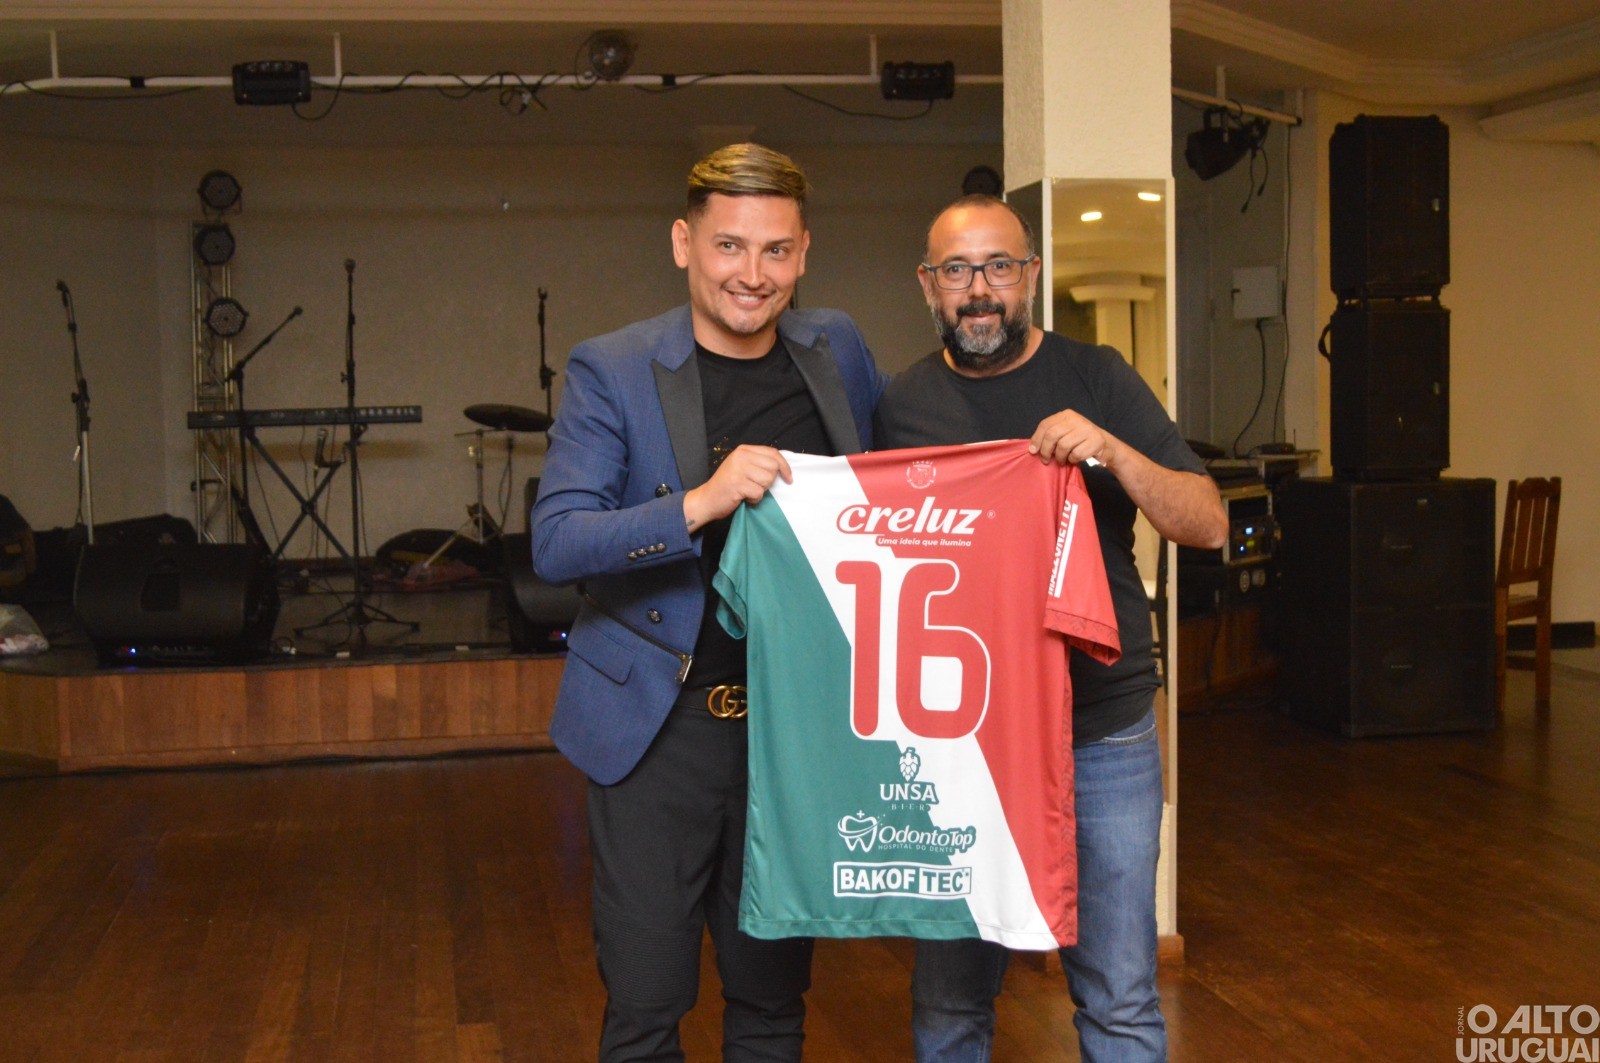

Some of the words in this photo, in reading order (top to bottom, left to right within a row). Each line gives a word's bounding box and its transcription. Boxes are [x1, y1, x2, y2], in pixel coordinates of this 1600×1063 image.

[838, 496, 983, 535] creluz
[877, 537, 898, 545] Uma
[899, 537, 921, 546] ideia
[921, 539, 938, 547] que
[939, 538, 972, 547] ilumina
[835, 559, 991, 740] 16
[879, 783, 937, 803] UNSA
[929, 845, 953, 853] DENTE
[840, 868, 916, 891] BAKOF
[922, 870, 964, 893] TEC
